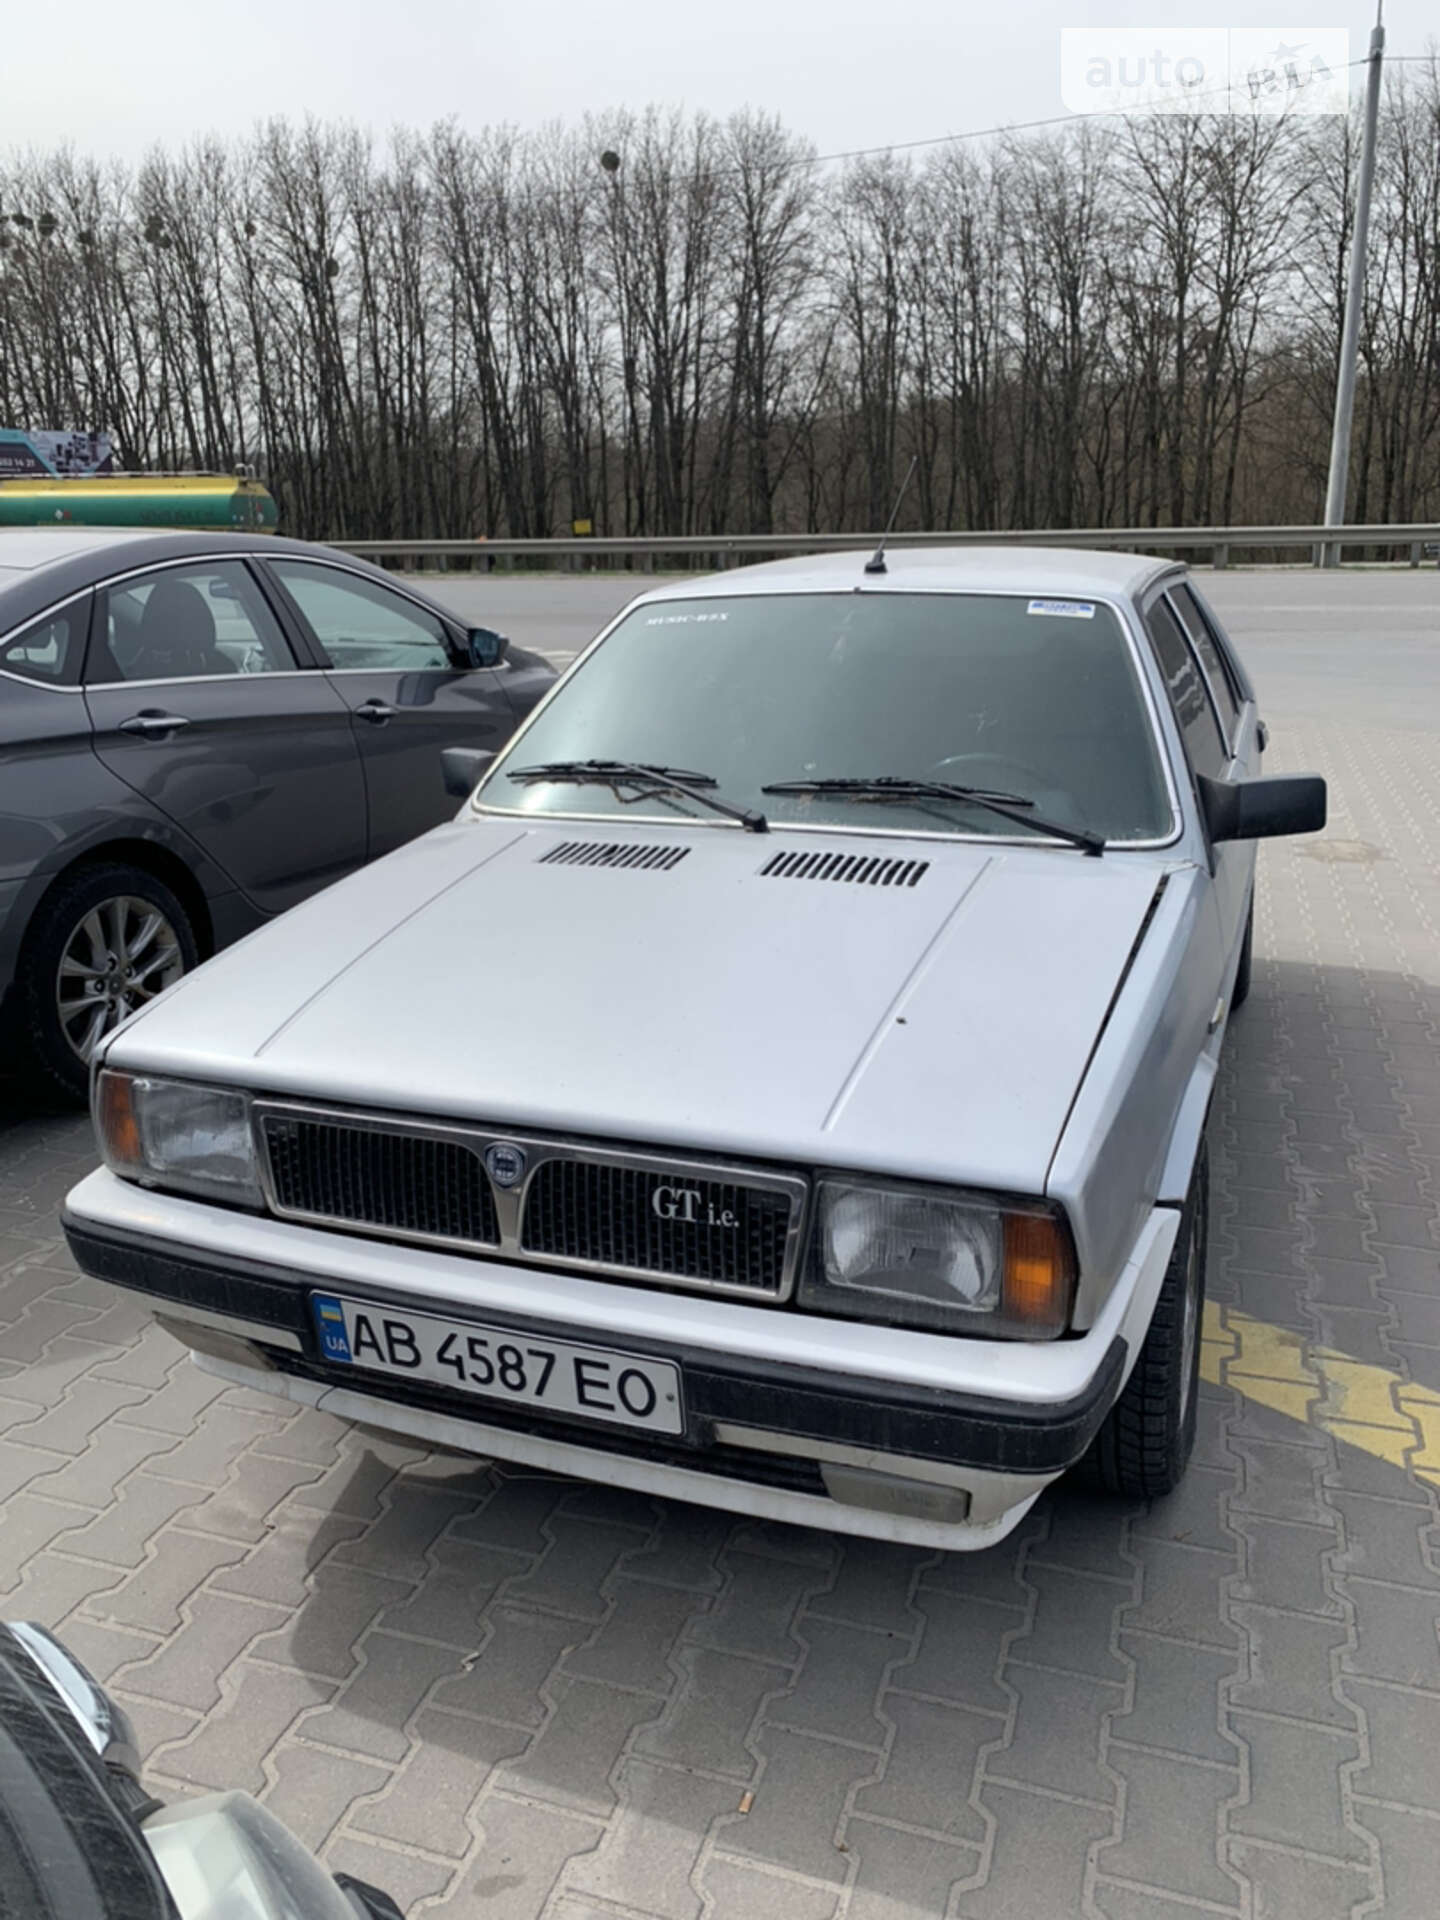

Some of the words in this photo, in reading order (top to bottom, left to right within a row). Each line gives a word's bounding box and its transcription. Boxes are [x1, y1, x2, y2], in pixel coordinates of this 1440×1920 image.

[652, 1185, 702, 1222] GT
[708, 1202, 740, 1227] i.e.
[325, 1336, 349, 1353] UA
[353, 1314, 421, 1368] AB
[436, 1333, 556, 1396] 4587
[574, 1357, 657, 1417] EO
